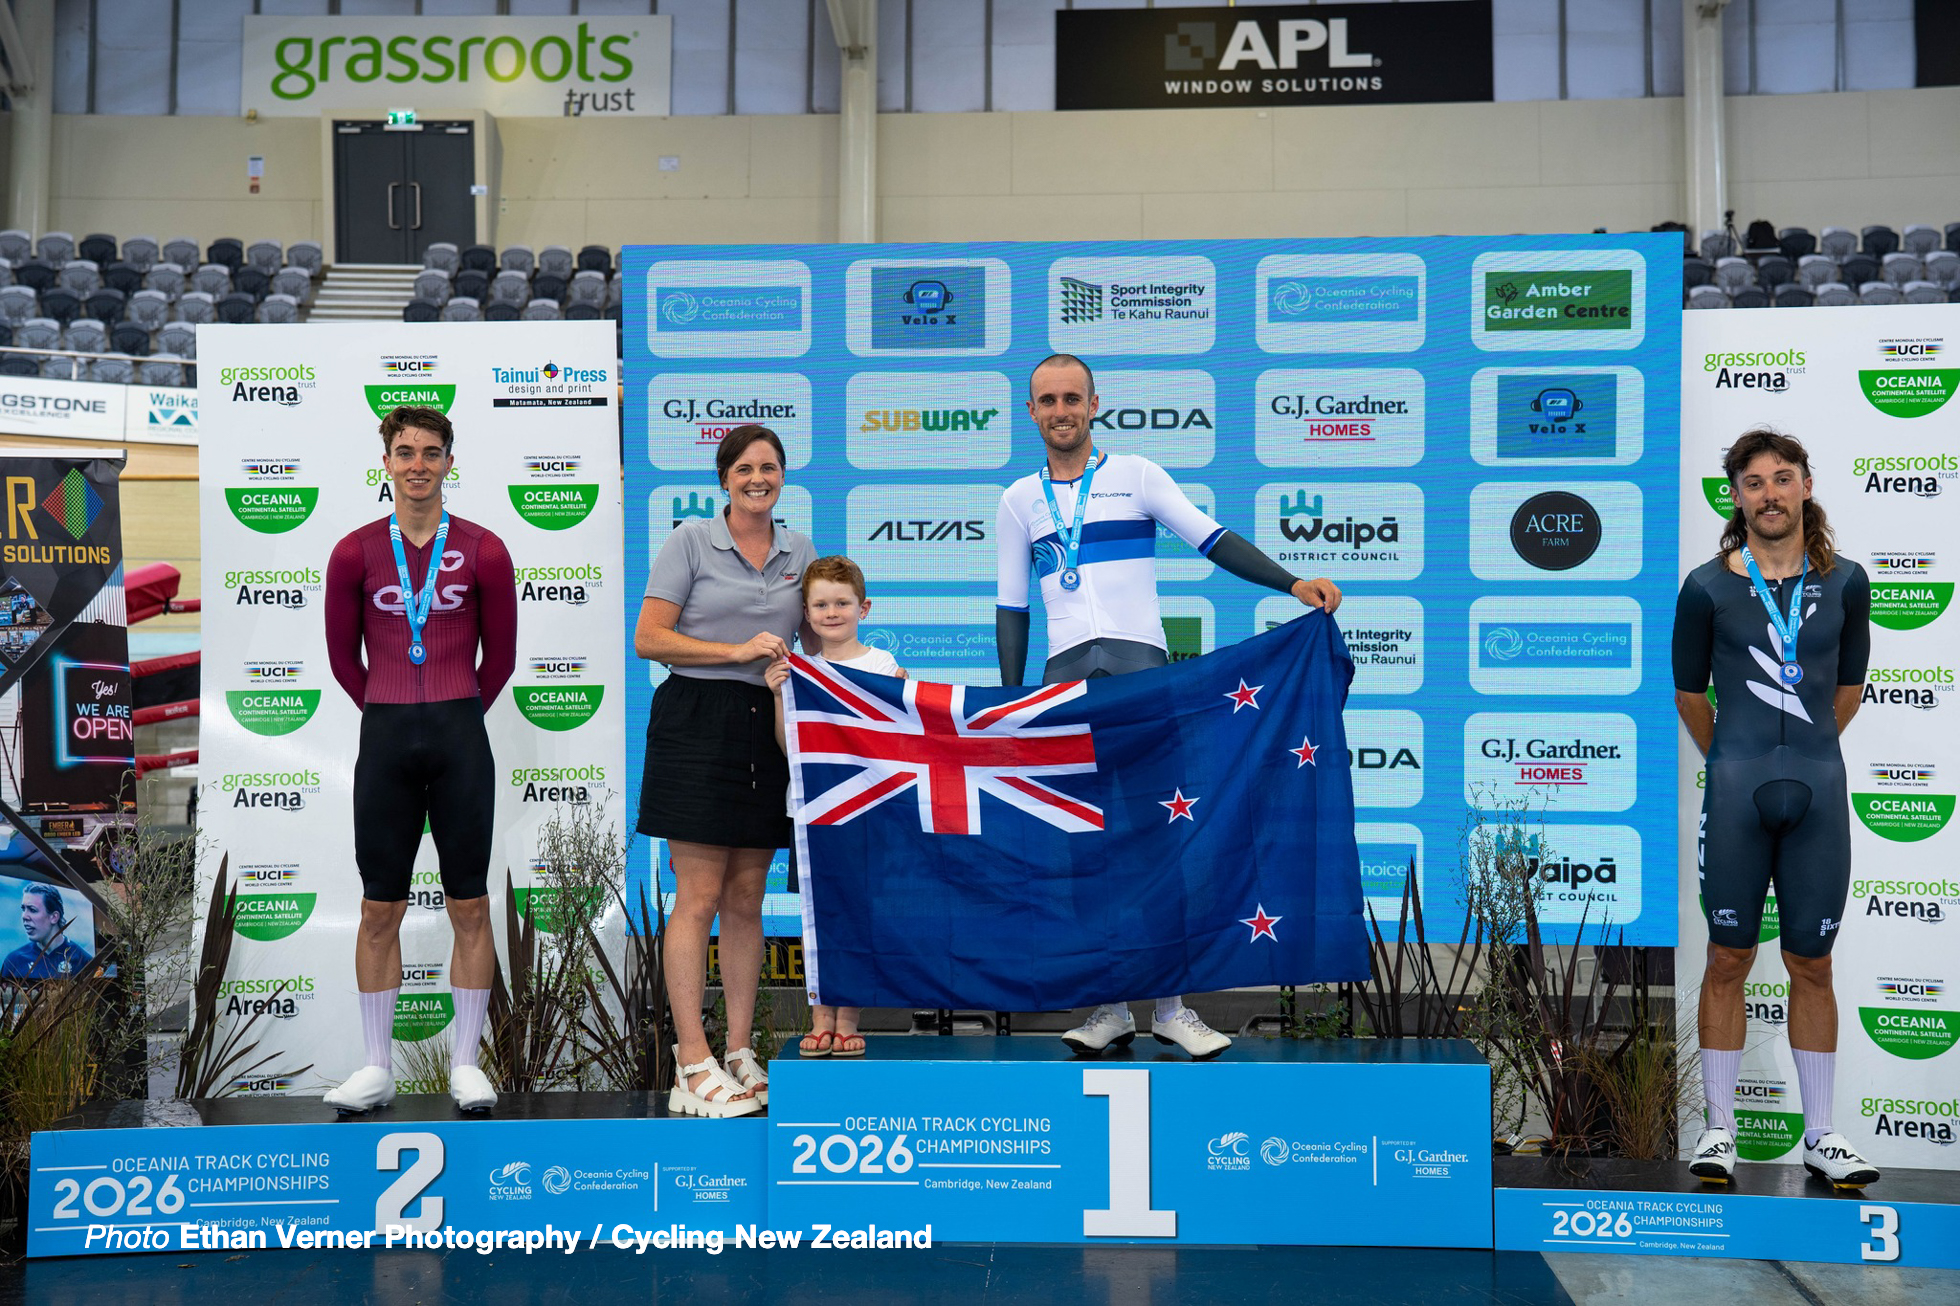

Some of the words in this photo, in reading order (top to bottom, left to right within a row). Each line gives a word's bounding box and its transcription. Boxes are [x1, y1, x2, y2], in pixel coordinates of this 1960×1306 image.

[1217, 17, 1373, 71] APL
[270, 21, 634, 101] grassroots
[1164, 79, 1253, 95] WINDOW
[1262, 76, 1383, 93] SOLUTIONS
[565, 87, 635, 112] trust
[1110, 284, 1147, 297] Sport
[1150, 283, 1205, 296] Integrity
[1315, 287, 1366, 297] Oceania
[1370, 285, 1414, 298] Cycling
[1525, 283, 1592, 298] Amber
[702, 296, 751, 307] Oceania
[755, 295, 797, 308] Cycling
[1110, 296, 1192, 307] Commission
[1315, 300, 1400, 311] Confederation
[702, 309, 784, 321] Confederation
[1111, 309, 1126, 320] Te
[1129, 308, 1161, 319] Kahu
[1165, 308, 1209, 319] Raunui
[1487, 304, 1558, 319] Garden
[1563, 304, 1630, 318] Centre
[901, 315, 938, 326] Velo
[946, 315, 957, 325] X
[1897, 345, 1924, 355] UCI
[397, 361, 422, 371] UCI
[1703, 348, 1806, 372] grassroots
[220, 363, 315, 386] grassroots
[492, 367, 540, 383] Tainui
[563, 367, 607, 382] Press
[1715, 367, 1786, 389] Arena
[1876, 376, 1942, 388] OCEANIA
[232, 381, 298, 402] Arena
[380, 391, 440, 402] OCEANIA
[508, 384, 542, 395] design
[545, 383, 564, 393] and
[568, 383, 592, 395] print
[1, 393, 107, 414] GSTONE
[149, 393, 198, 408] Waika
[663, 399, 700, 423] G.J.
[706, 398, 796, 418] Gardner.
[1271, 395, 1310, 419] G.J.
[1315, 394, 1409, 414] Gardner.
[860, 408, 999, 433] SUBWAY
[1089, 408, 1213, 430] KODA
[1309, 424, 1371, 436] HOMES
[1528, 424, 1567, 434] Velo
[1575, 423, 1586, 434] X
[1852, 453, 1958, 476] grassroots
[1864, 472, 1937, 493] Arena
[241, 494, 302, 505] OCEANIA
[1524, 513, 1584, 533] ACRE
[1279, 516, 1398, 549] Waipā
[1542, 538, 1569, 547] FARM
[3, 545, 111, 565] SOLUTIONS
[1279, 552, 1337, 561] DISTRICT
[1341, 552, 1399, 561] COUNCIL
[224, 566, 321, 589] grassroots
[236, 585, 303, 605] Arena
[521, 581, 585, 601] Arena
[903, 633, 952, 645] Oceania
[957, 632, 997, 647] Cycling
[1356, 629, 1412, 642] Integrity
[1526, 632, 1578, 643] Oceania
[1583, 631, 1627, 646] Cycling
[903, 646, 985, 658] Confederation
[1526, 645, 1613, 657] Confederation
[1375, 653, 1416, 665] Raunui
[91, 680, 119, 700] Yes!
[242, 696, 304, 708] OCEANIA
[76, 703, 101, 717] WE
[105, 704, 130, 718] ARE
[73, 717, 133, 741] OPEN
[1481, 739, 1520, 763] G.J.
[1526, 739, 1621, 759] Gardner.
[222, 769, 321, 792] grassroots
[1520, 767, 1583, 780] HOMES
[1889, 770, 1916, 780] UCI
[233, 787, 301, 808] Arena
[1869, 800, 1937, 812] OCEANIA
[1852, 878, 1960, 899] grassroots
[1866, 895, 1940, 918] Arena
[1877, 1015, 1946, 1030] OCEANIA
[845, 1116, 918, 1132] OCEANIA
[921, 1116, 977, 1132] TRACK
[980, 1117, 1051, 1133] CYCLING
[792, 1134, 914, 1174] 2026
[916, 1138, 1051, 1155] CHAMPIONSHIPS
[1082, 1069, 1176, 1238] 1
[1291, 1141, 1331, 1151] Oceania
[1334, 1141, 1368, 1154] Cycling
[112, 1156, 190, 1173] OCEANIA
[194, 1154, 253, 1170] TRACK
[256, 1152, 331, 1169] CYCLING
[1207, 1156, 1250, 1165] CYCLING
[1291, 1153, 1357, 1163] Confederation
[1394, 1149, 1416, 1164] G.J.
[1417, 1149, 1469, 1163] Gardner.
[573, 1169, 613, 1179] Oceania
[615, 1168, 649, 1181] Cycling
[1415, 1167, 1449, 1176] HOMES
[375, 1131, 445, 1237] 2
[573, 1180, 639, 1191] Confederation
[675, 1174, 696, 1189] G.J.
[698, 1173, 748, 1187] Gardner.
[924, 1178, 983, 1191] Cambridge,
[986, 1178, 1009, 1189] New
[1011, 1178, 1052, 1190] Zealand
[53, 1174, 186, 1219] 2026
[188, 1175, 330, 1193] CHAMPIONSHIPS
[489, 1186, 532, 1195] CYCLING
[695, 1191, 728, 1200] HOMES
[1586, 1200, 1635, 1211] OCEANIA
[1637, 1201, 1674, 1212] TRACK
[1675, 1202, 1723, 1214] CYCLING
[195, 1217, 258, 1231] Cambridge,
[261, 1216, 284, 1226] New
[287, 1215, 330, 1226] Zealand
[1553, 1210, 1633, 1238] 2026
[1633, 1215, 1724, 1228] CHAMPIONSHIPS
[1859, 1204, 1901, 1262] 3
[1680, 1242, 1696, 1250] New
[1697, 1243, 1725, 1251] Zealand
